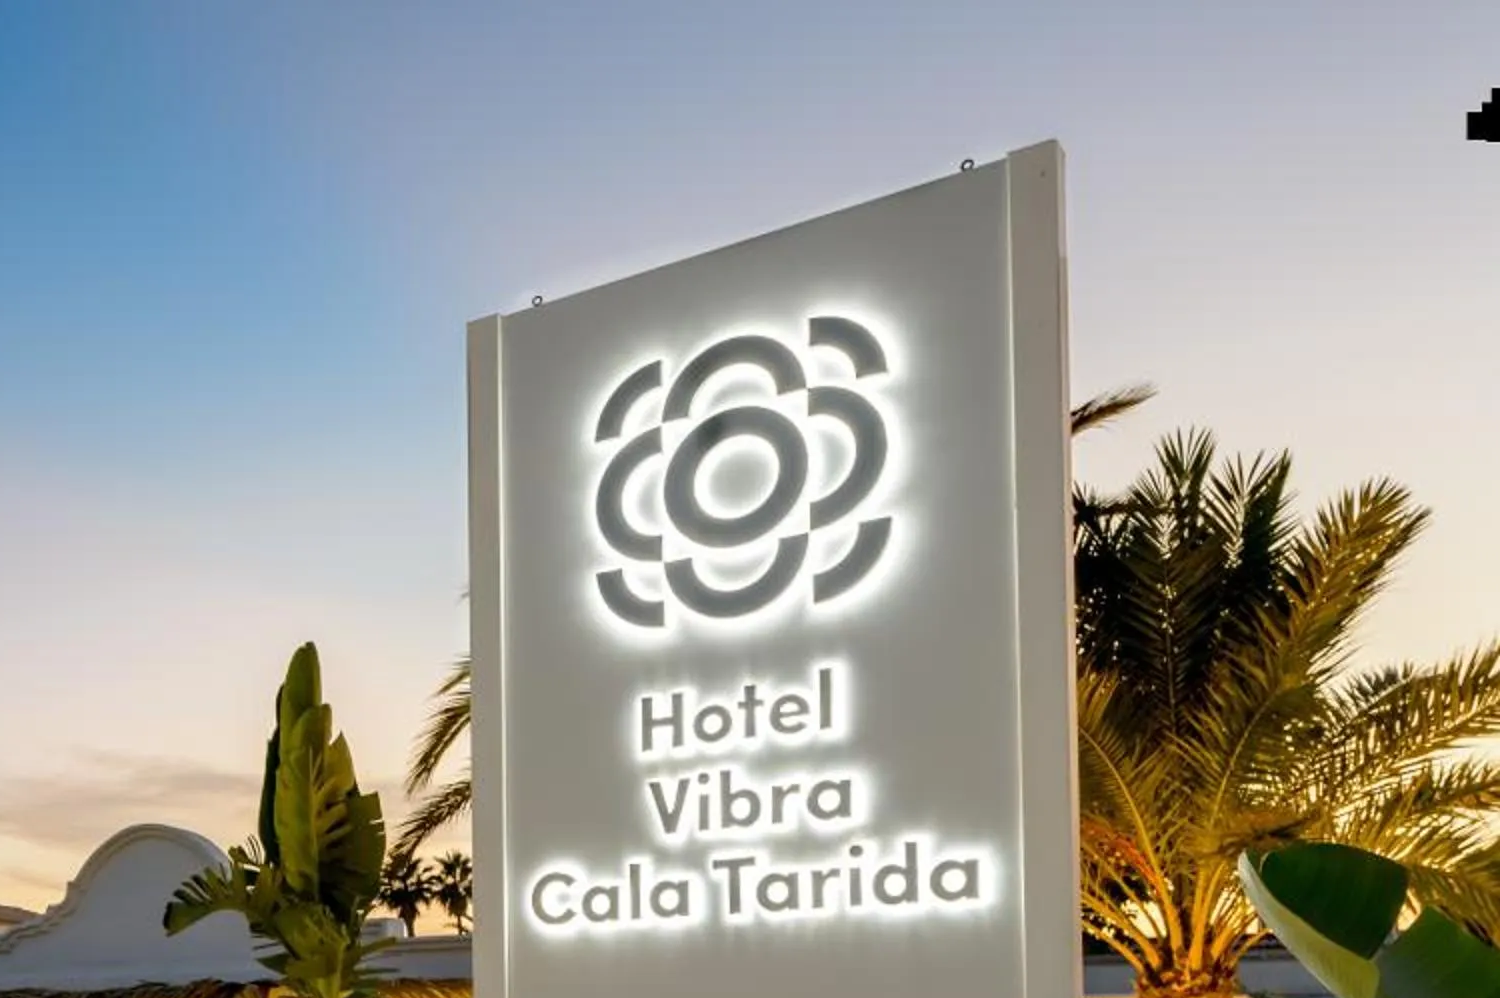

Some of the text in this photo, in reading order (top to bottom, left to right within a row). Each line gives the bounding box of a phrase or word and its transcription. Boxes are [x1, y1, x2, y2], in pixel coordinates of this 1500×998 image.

[640, 668, 833, 752] Hotel
[649, 769, 853, 834] Vibra
[530, 841, 981, 925] Cala Tarida
